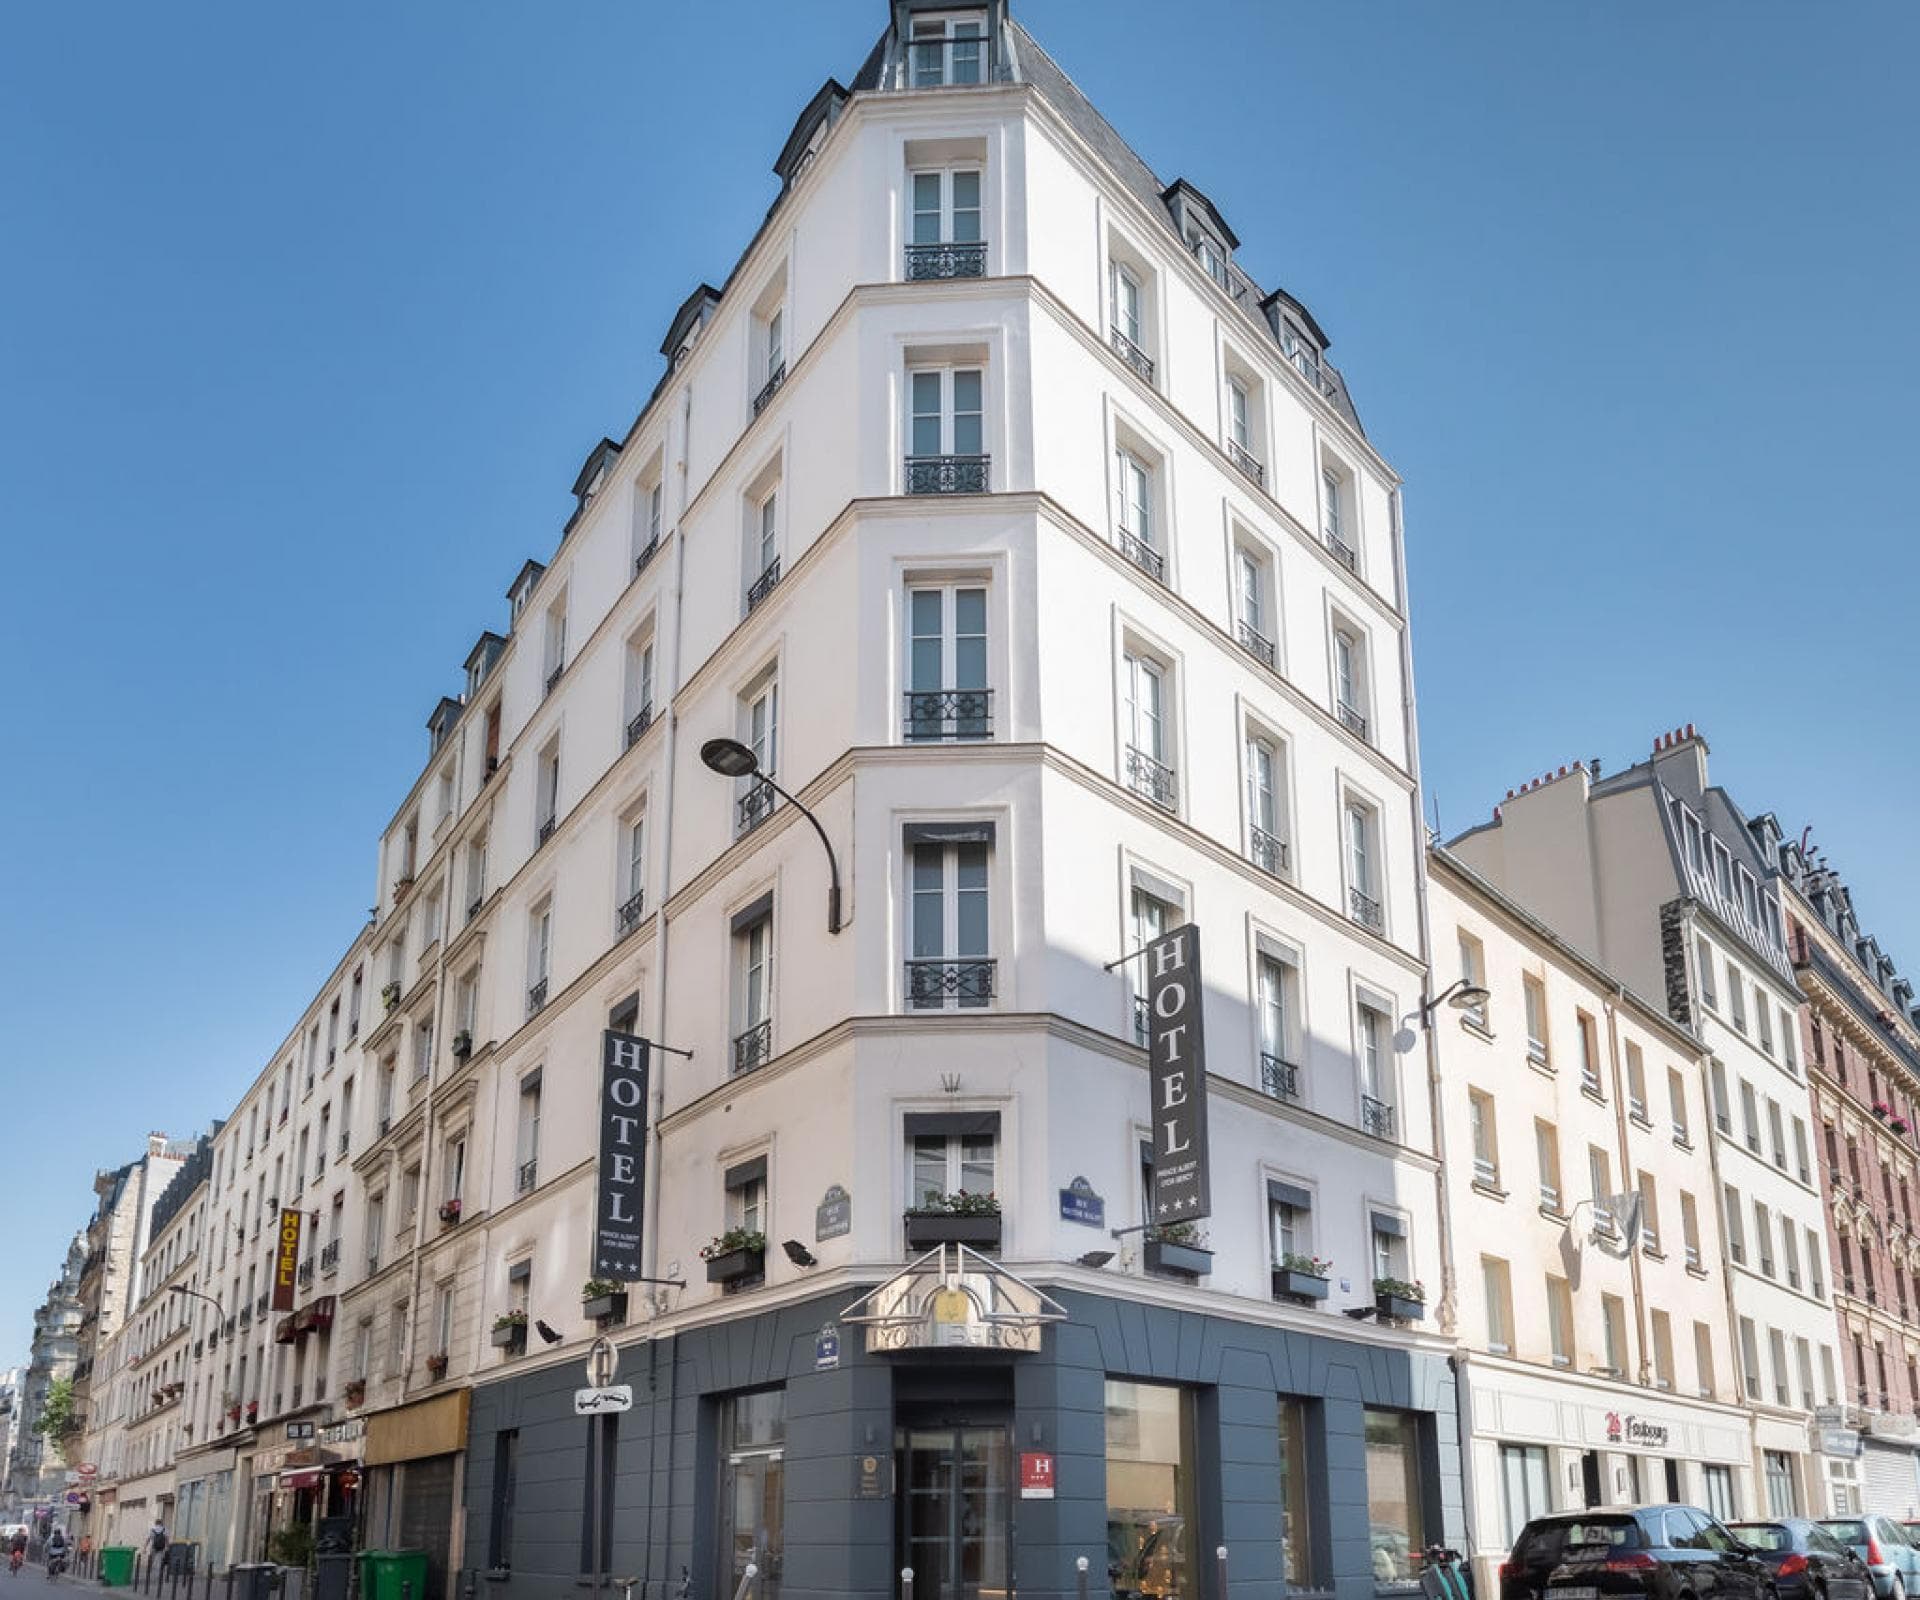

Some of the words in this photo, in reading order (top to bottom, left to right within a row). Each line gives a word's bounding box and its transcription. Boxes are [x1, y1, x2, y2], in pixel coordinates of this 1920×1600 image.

[1154, 935, 1190, 1156] HOTEL
[608, 1038, 643, 1223] HOTEL
[280, 1211, 299, 1286] HOTEL
[1036, 1458, 1049, 1473] H
